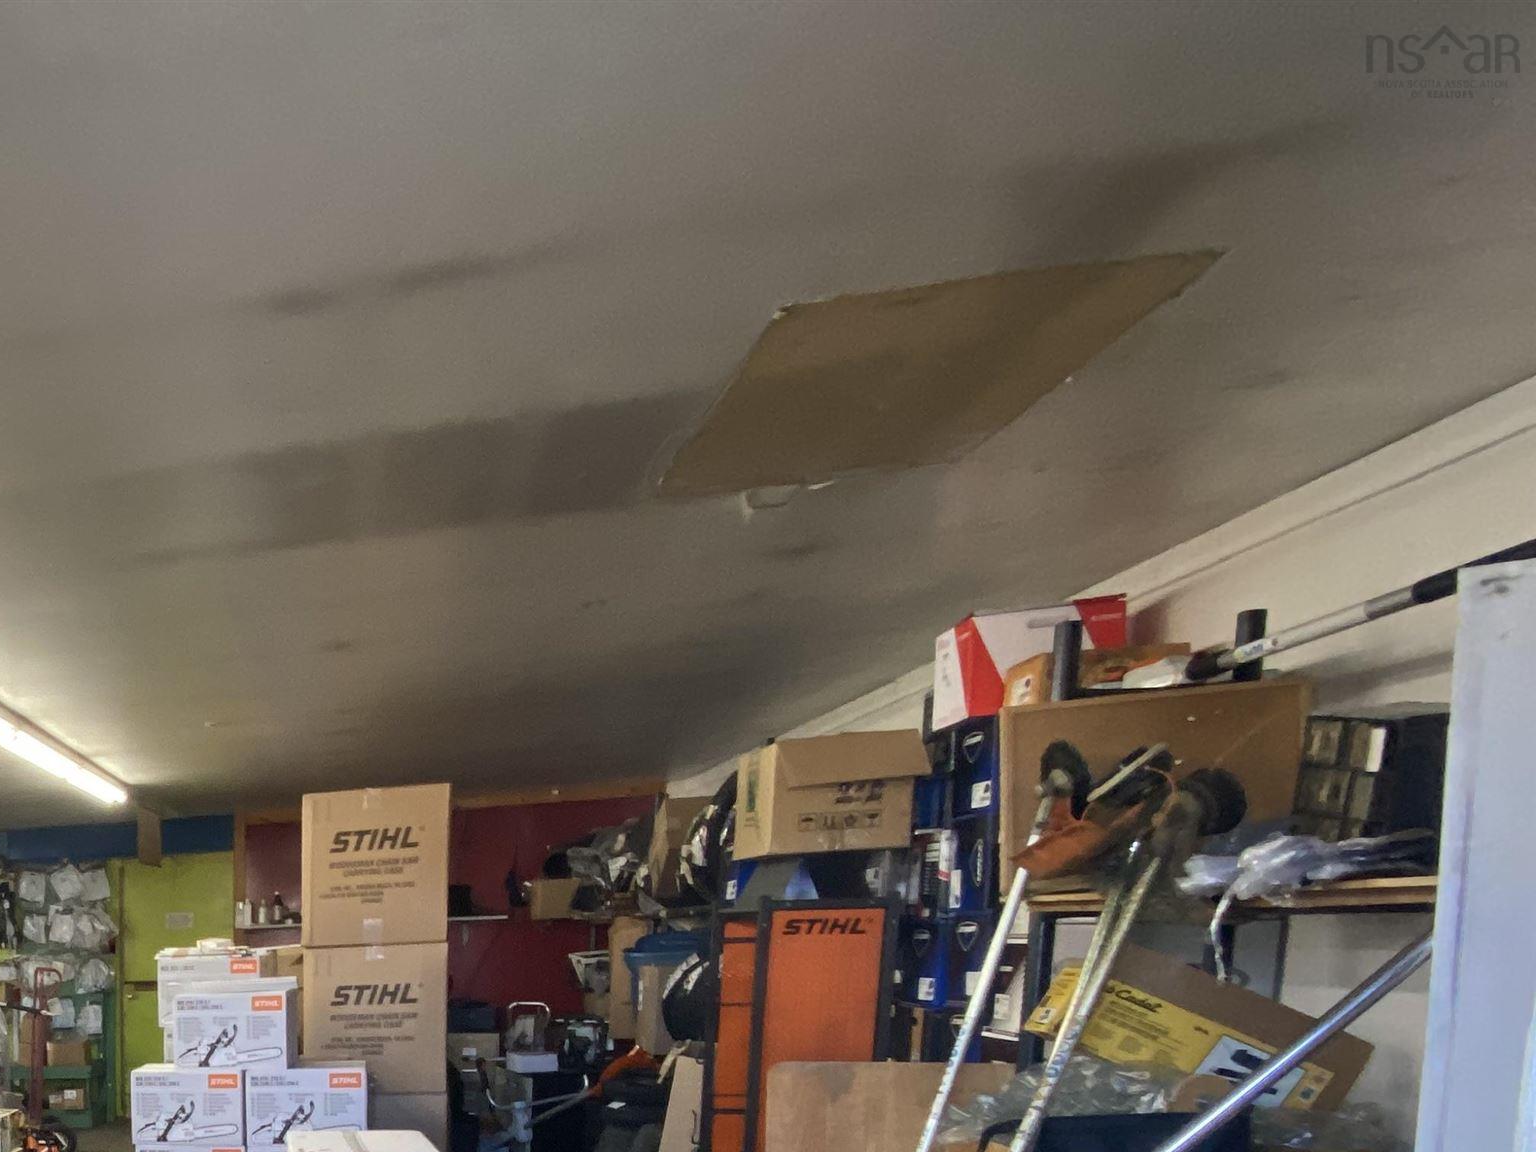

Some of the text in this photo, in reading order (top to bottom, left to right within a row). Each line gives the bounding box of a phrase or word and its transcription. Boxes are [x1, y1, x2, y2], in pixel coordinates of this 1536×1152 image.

[329, 826, 419, 853] STIHL
[782, 917, 866, 935] STIHL
[330, 984, 418, 1006] STIHL
